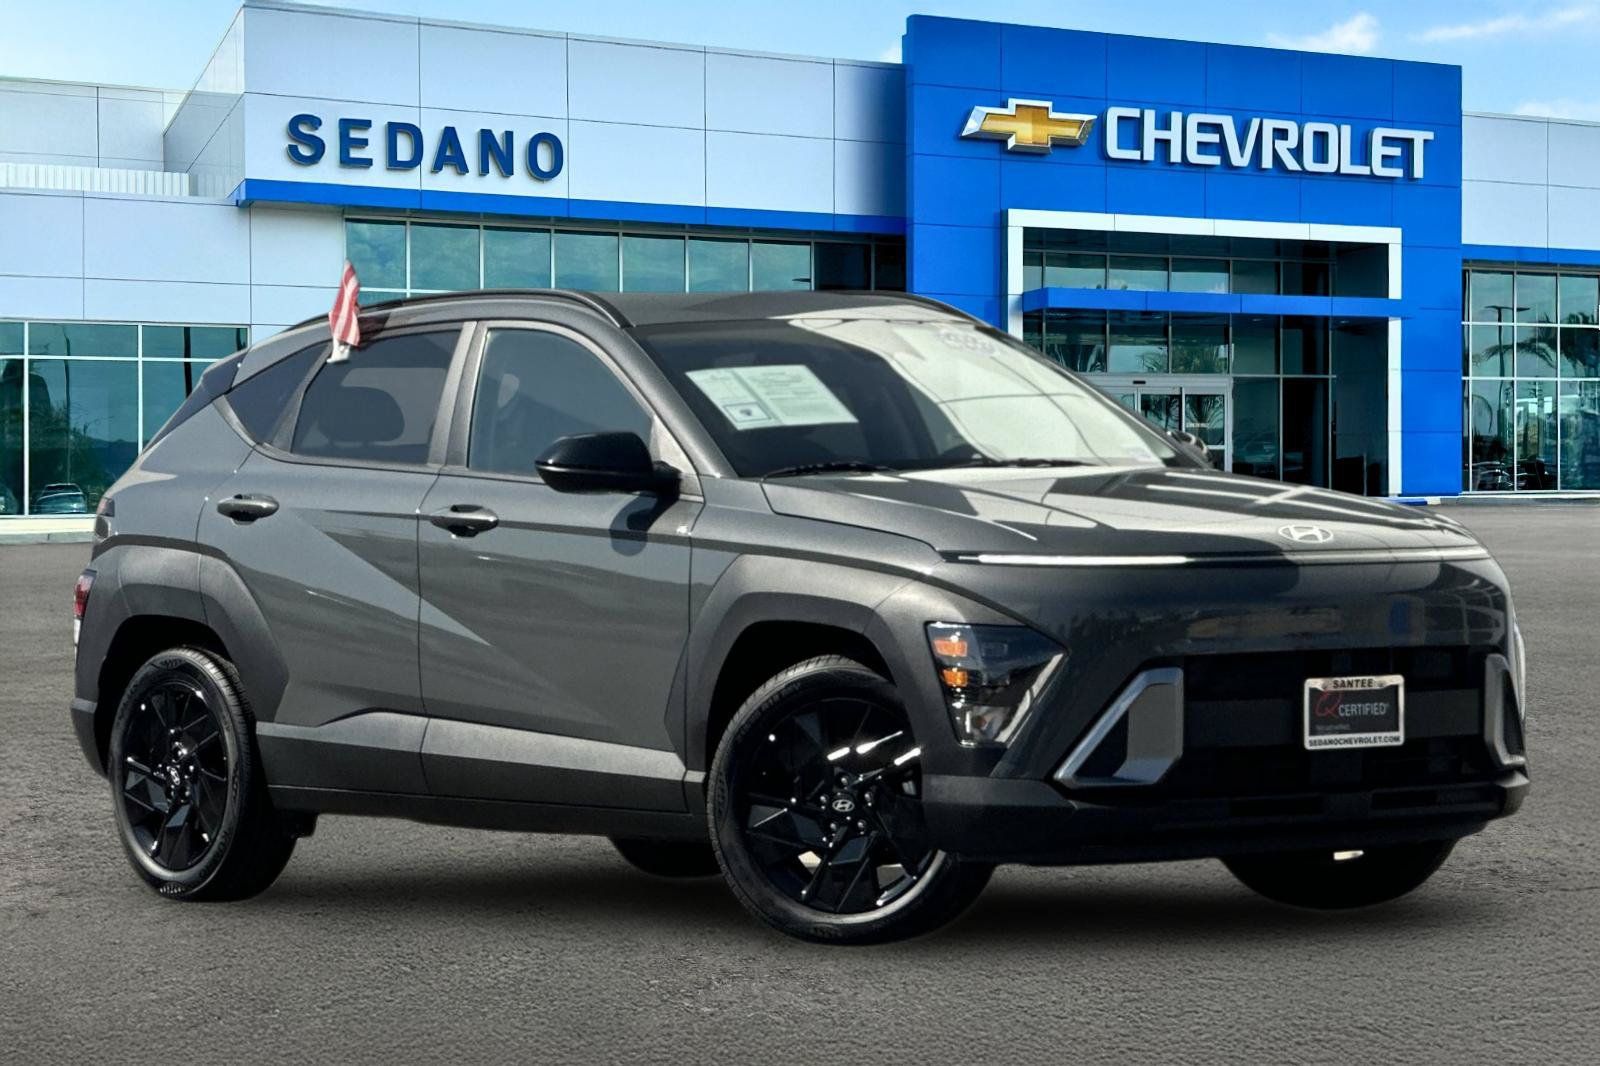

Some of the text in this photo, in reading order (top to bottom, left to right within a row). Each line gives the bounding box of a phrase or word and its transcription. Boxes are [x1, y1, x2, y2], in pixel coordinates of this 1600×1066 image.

[286, 113, 564, 182] SEDANO
[1106, 105, 1434, 179] CHEVROLET
[1333, 678, 1375, 689] SANTEE
[1338, 702, 1386, 717] CERTIFIED
[1309, 735, 1400, 747] SEDANOCHEVROLET.COM
